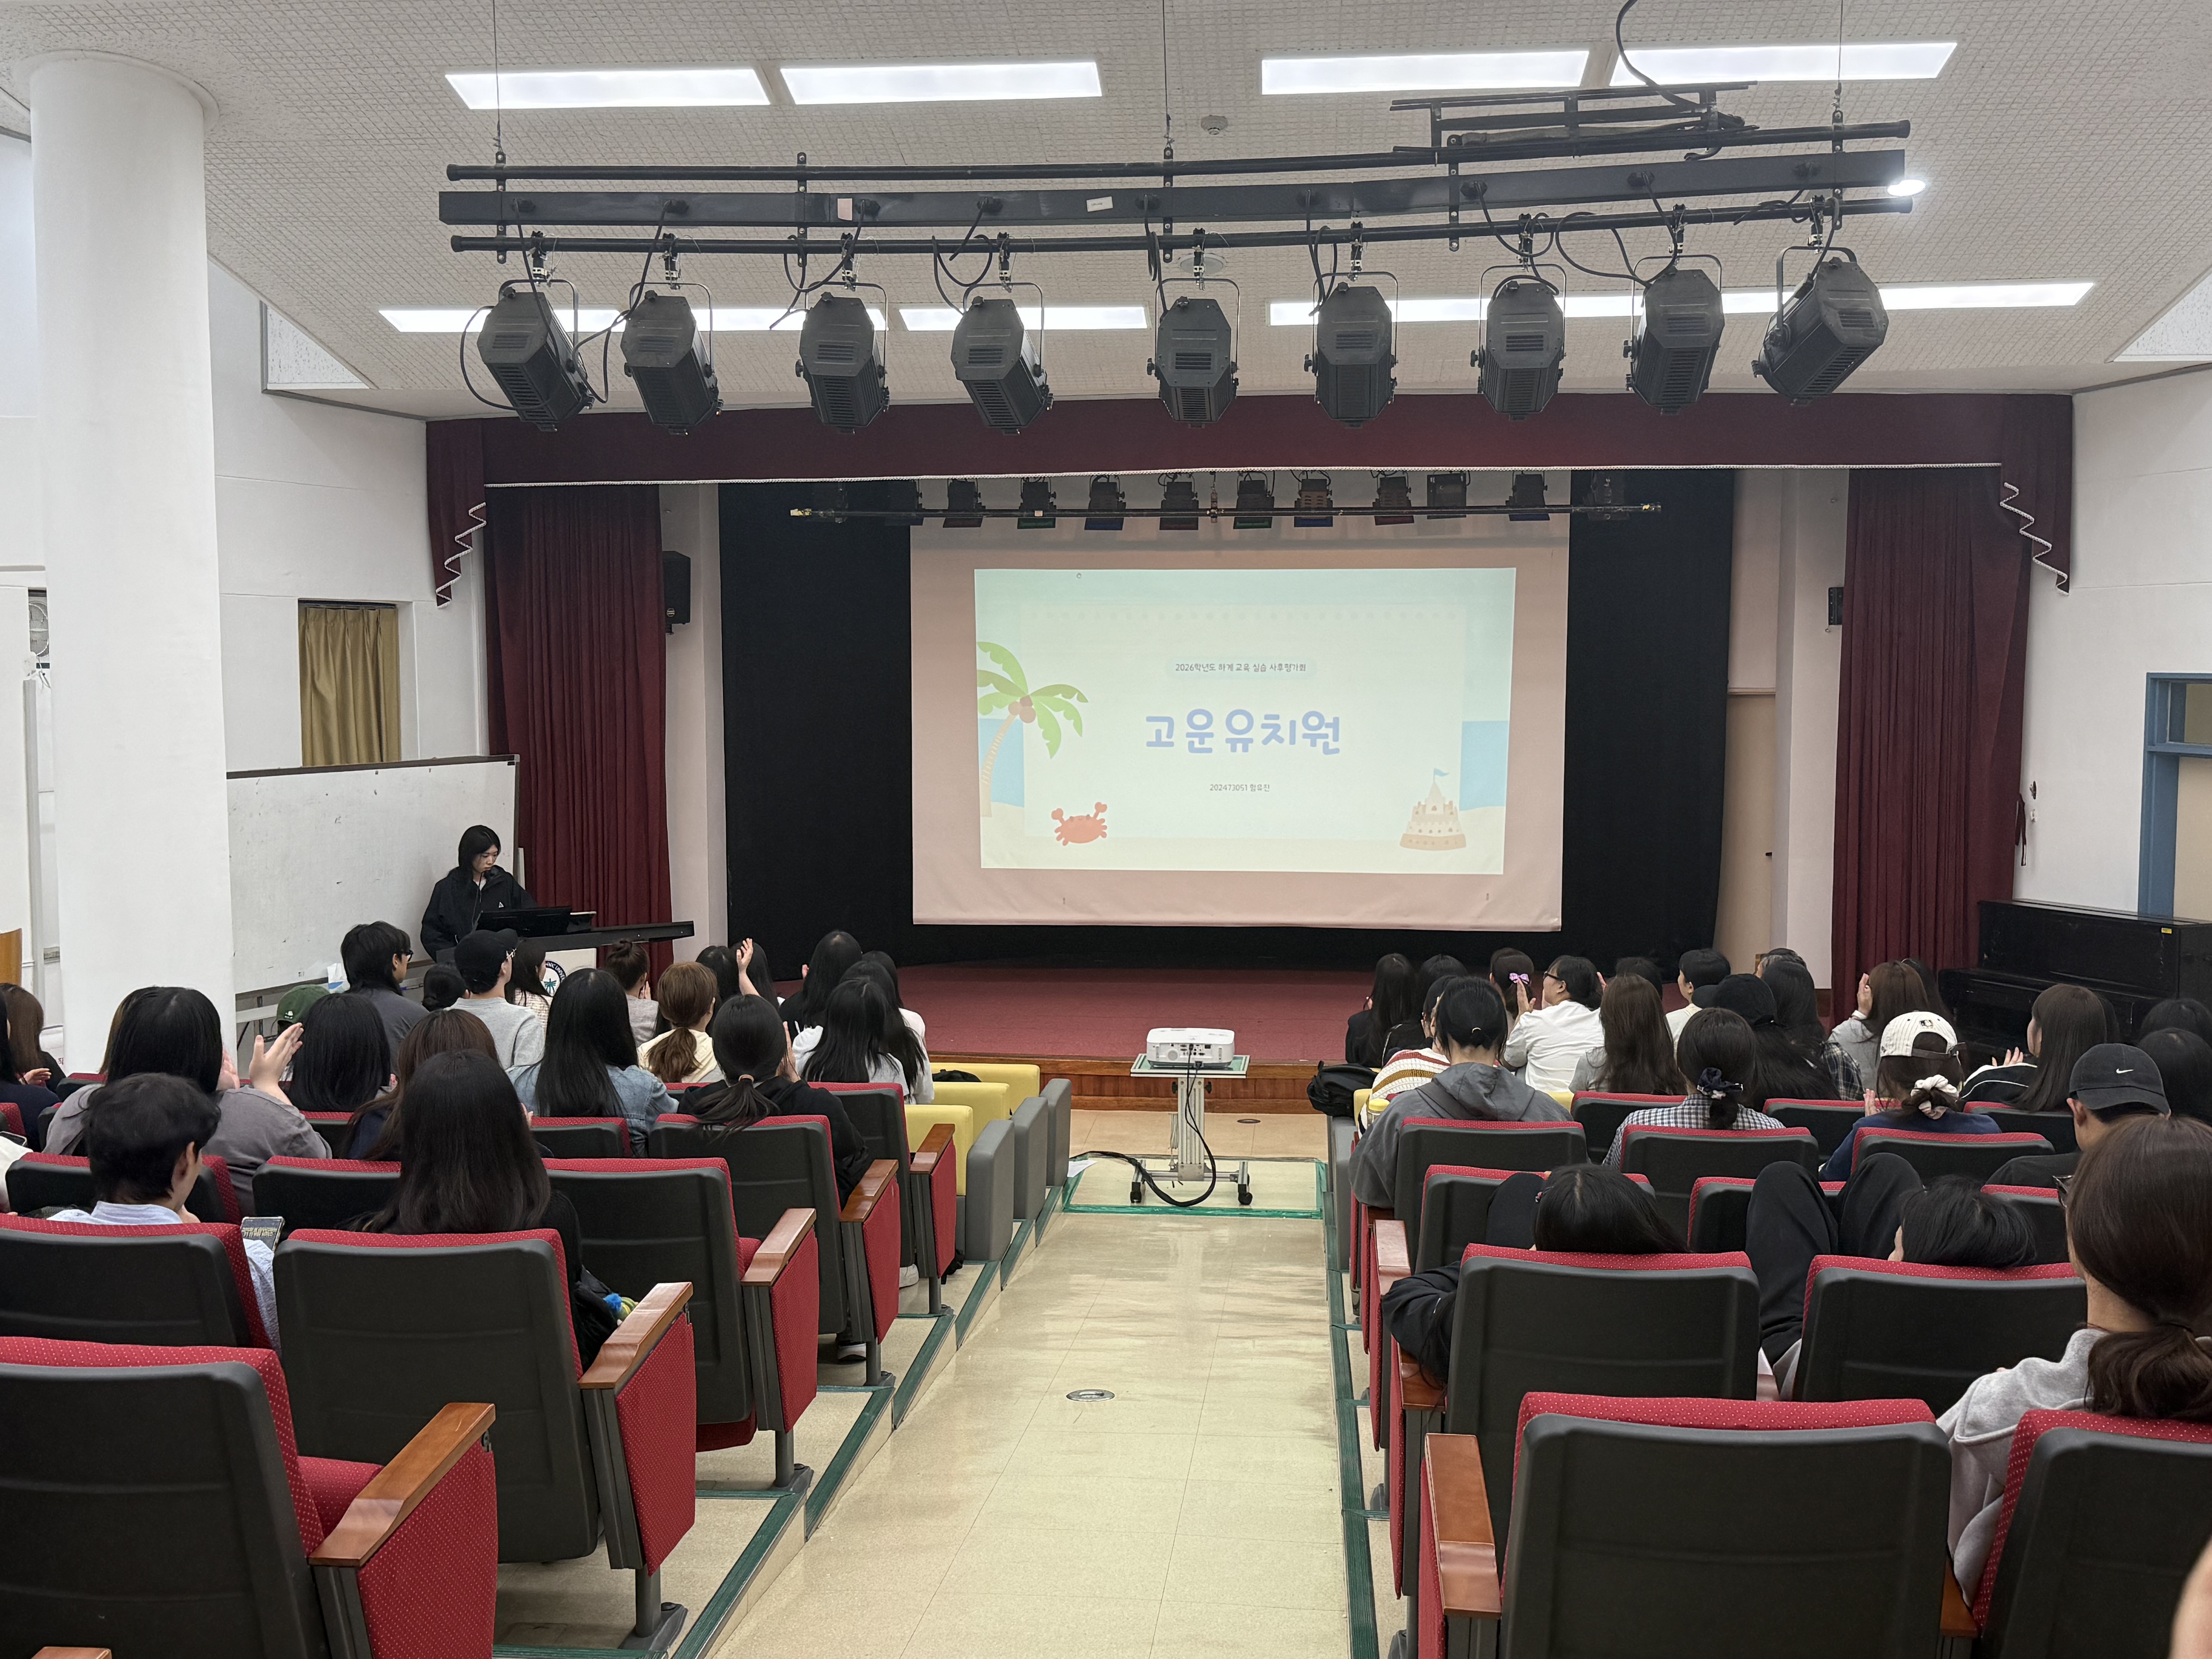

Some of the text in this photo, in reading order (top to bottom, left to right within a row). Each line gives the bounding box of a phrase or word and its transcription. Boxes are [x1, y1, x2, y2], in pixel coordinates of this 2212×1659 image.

[1175, 663, 1216, 672] 2026학년도
[1253, 663, 1267, 672] 실습
[1146, 709, 1340, 755] 고운유치원
